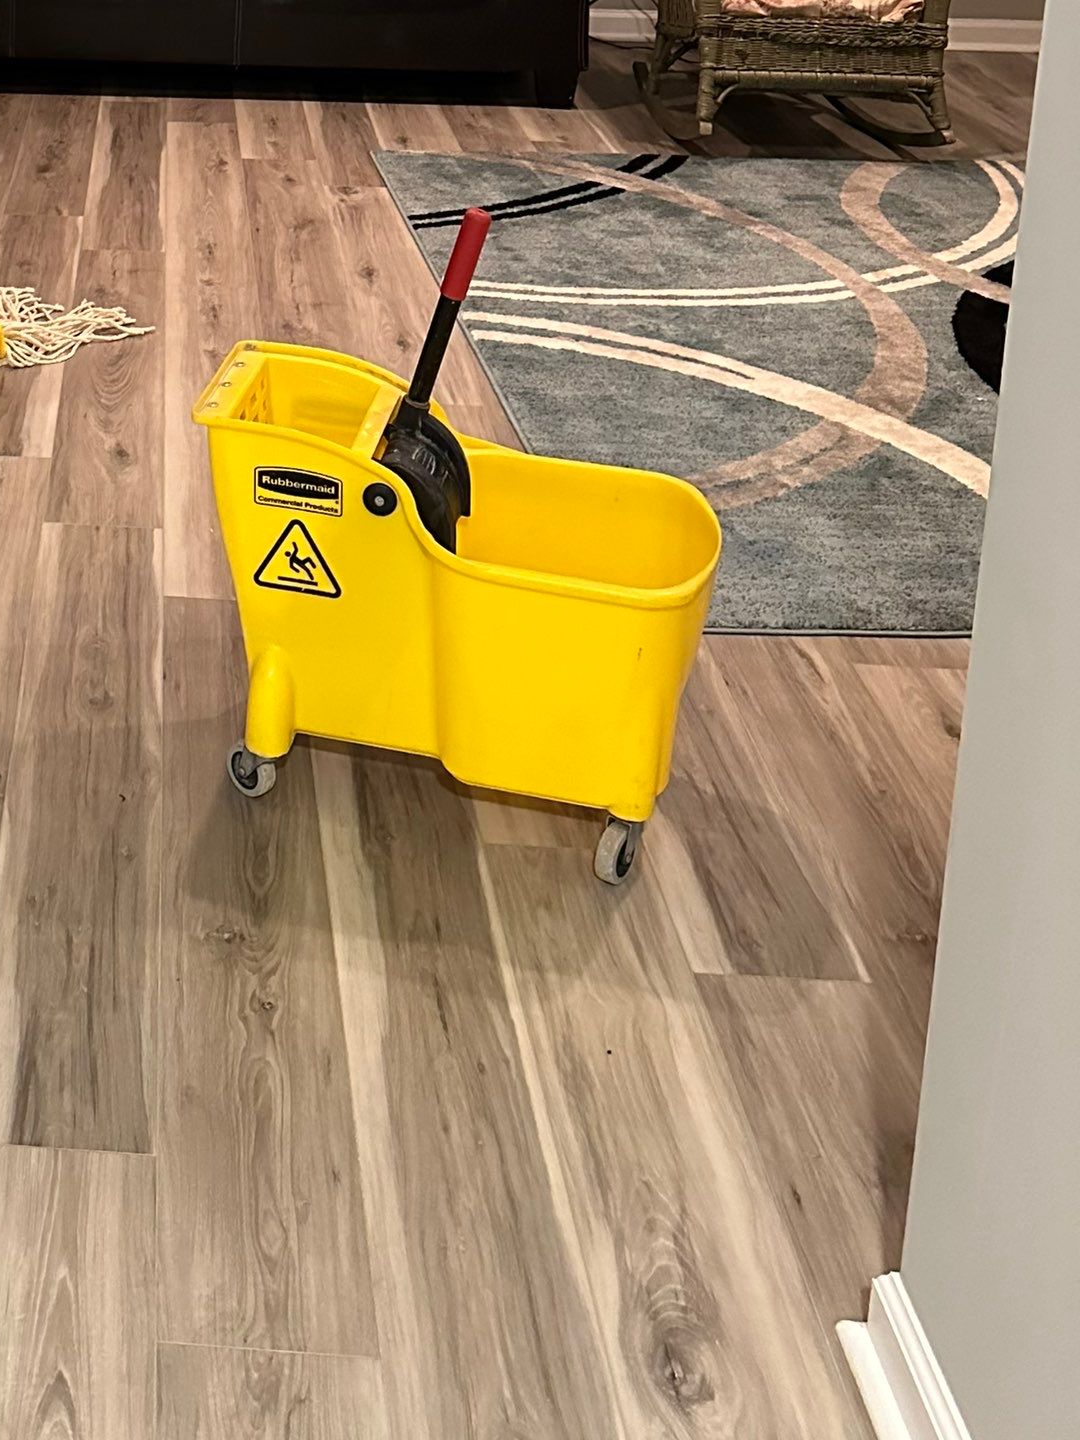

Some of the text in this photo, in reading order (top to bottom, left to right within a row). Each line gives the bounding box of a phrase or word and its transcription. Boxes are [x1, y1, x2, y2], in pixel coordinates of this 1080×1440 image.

[261, 475, 335, 494] Rubbermaid
[258, 495, 339, 514] Commercial Products
